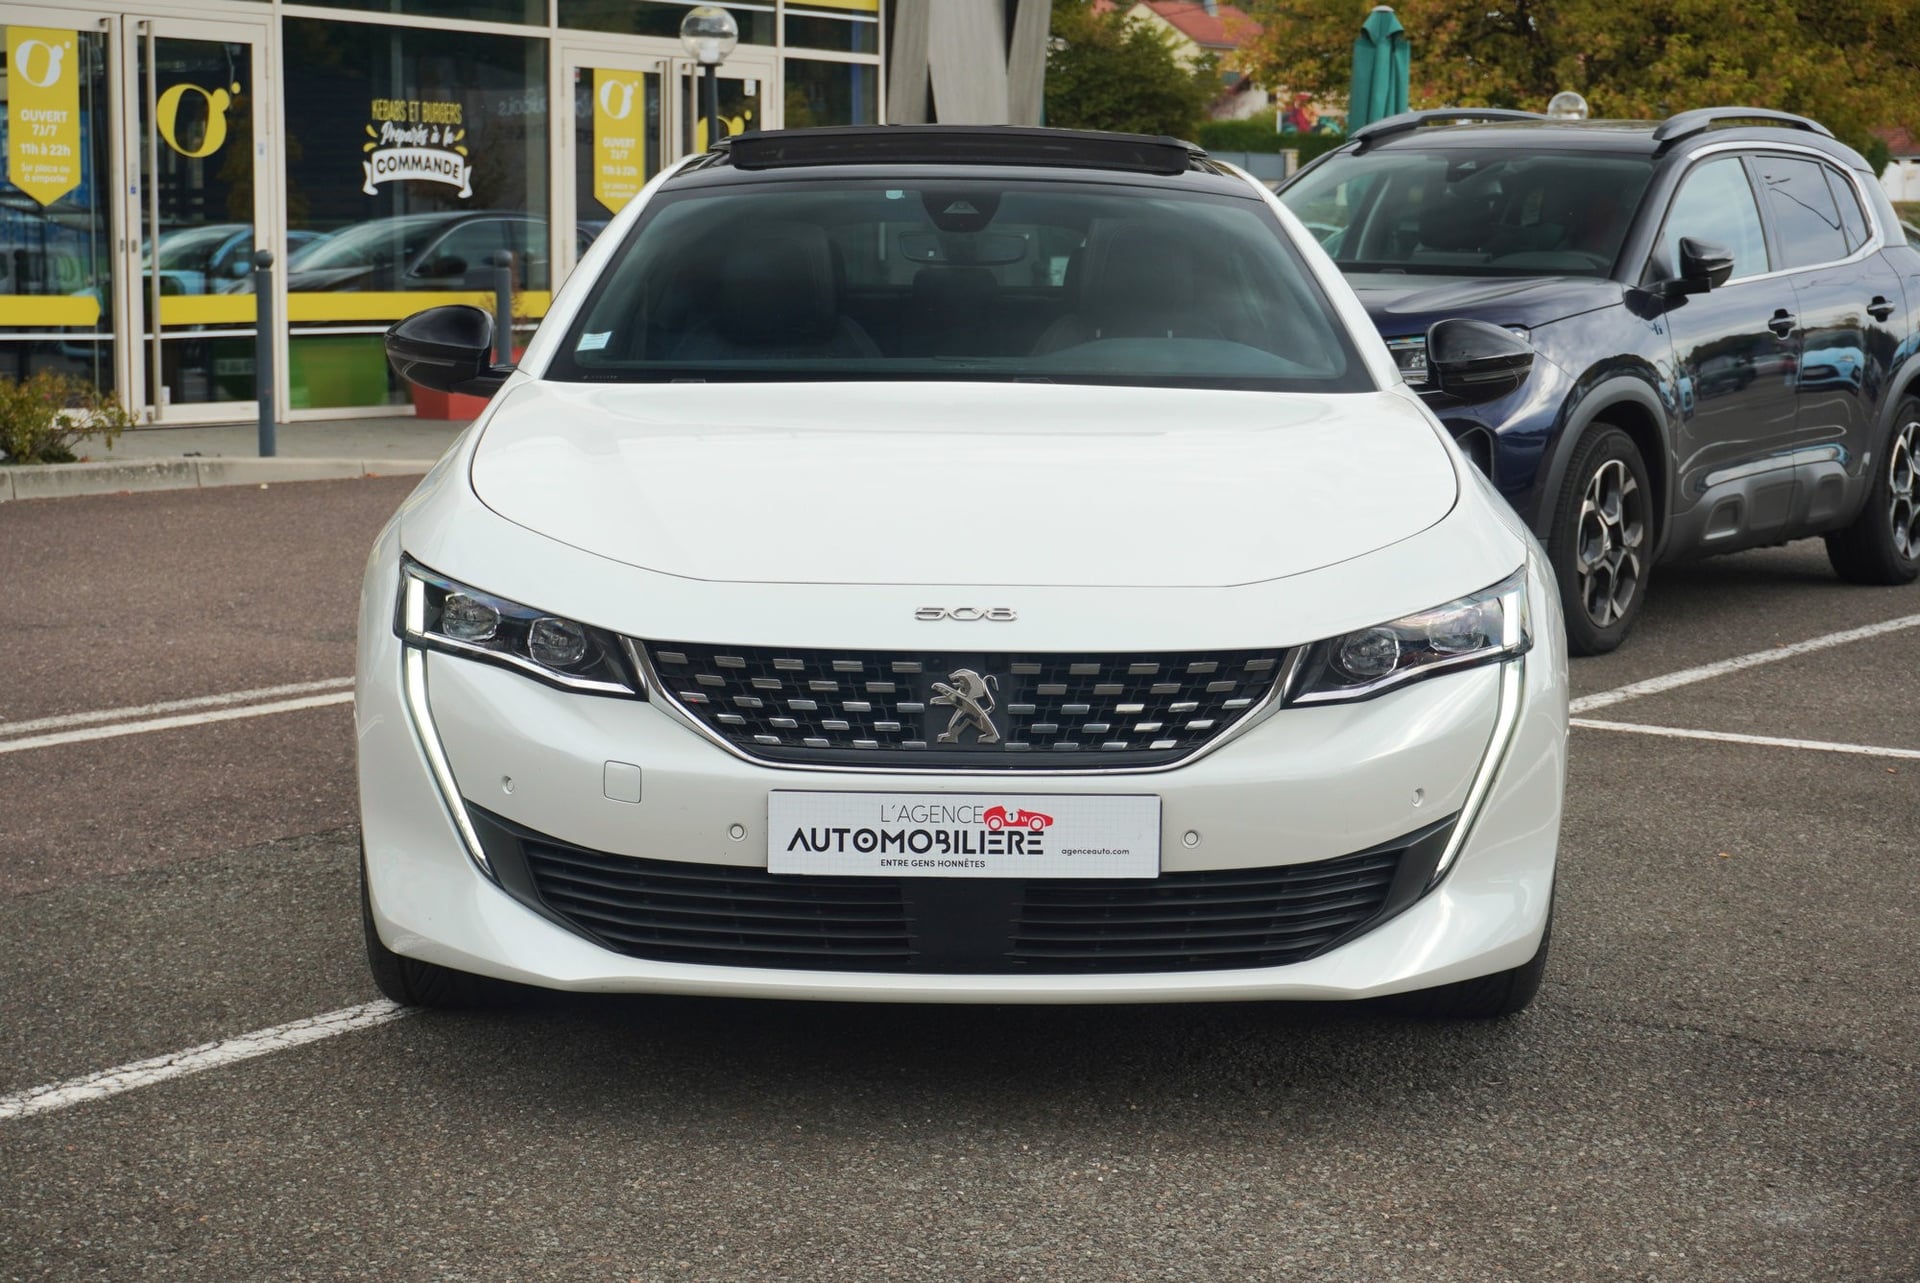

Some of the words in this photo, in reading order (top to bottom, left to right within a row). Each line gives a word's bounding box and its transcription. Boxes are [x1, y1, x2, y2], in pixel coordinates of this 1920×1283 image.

[21, 109, 68, 123] OUVERT
[371, 99, 406, 121] KEBABS
[408, 101, 420, 122] ET
[422, 102, 463, 124] BURGERS
[20, 144, 39, 155] 11h
[41, 143, 48, 155] à
[49, 144, 71, 156] 22h
[602, 137, 636, 148] OUVERT
[376, 155, 460, 179] COMMANDE
[914, 607, 1018, 621] 508
[880, 804, 984, 824] L'AGENCE
[1061, 847, 1130, 857] agenceauto.com
[880, 858, 909, 867] ENTRE
[911, 859, 936, 868] GENS
[938, 858, 986, 869] HONNÊTES
